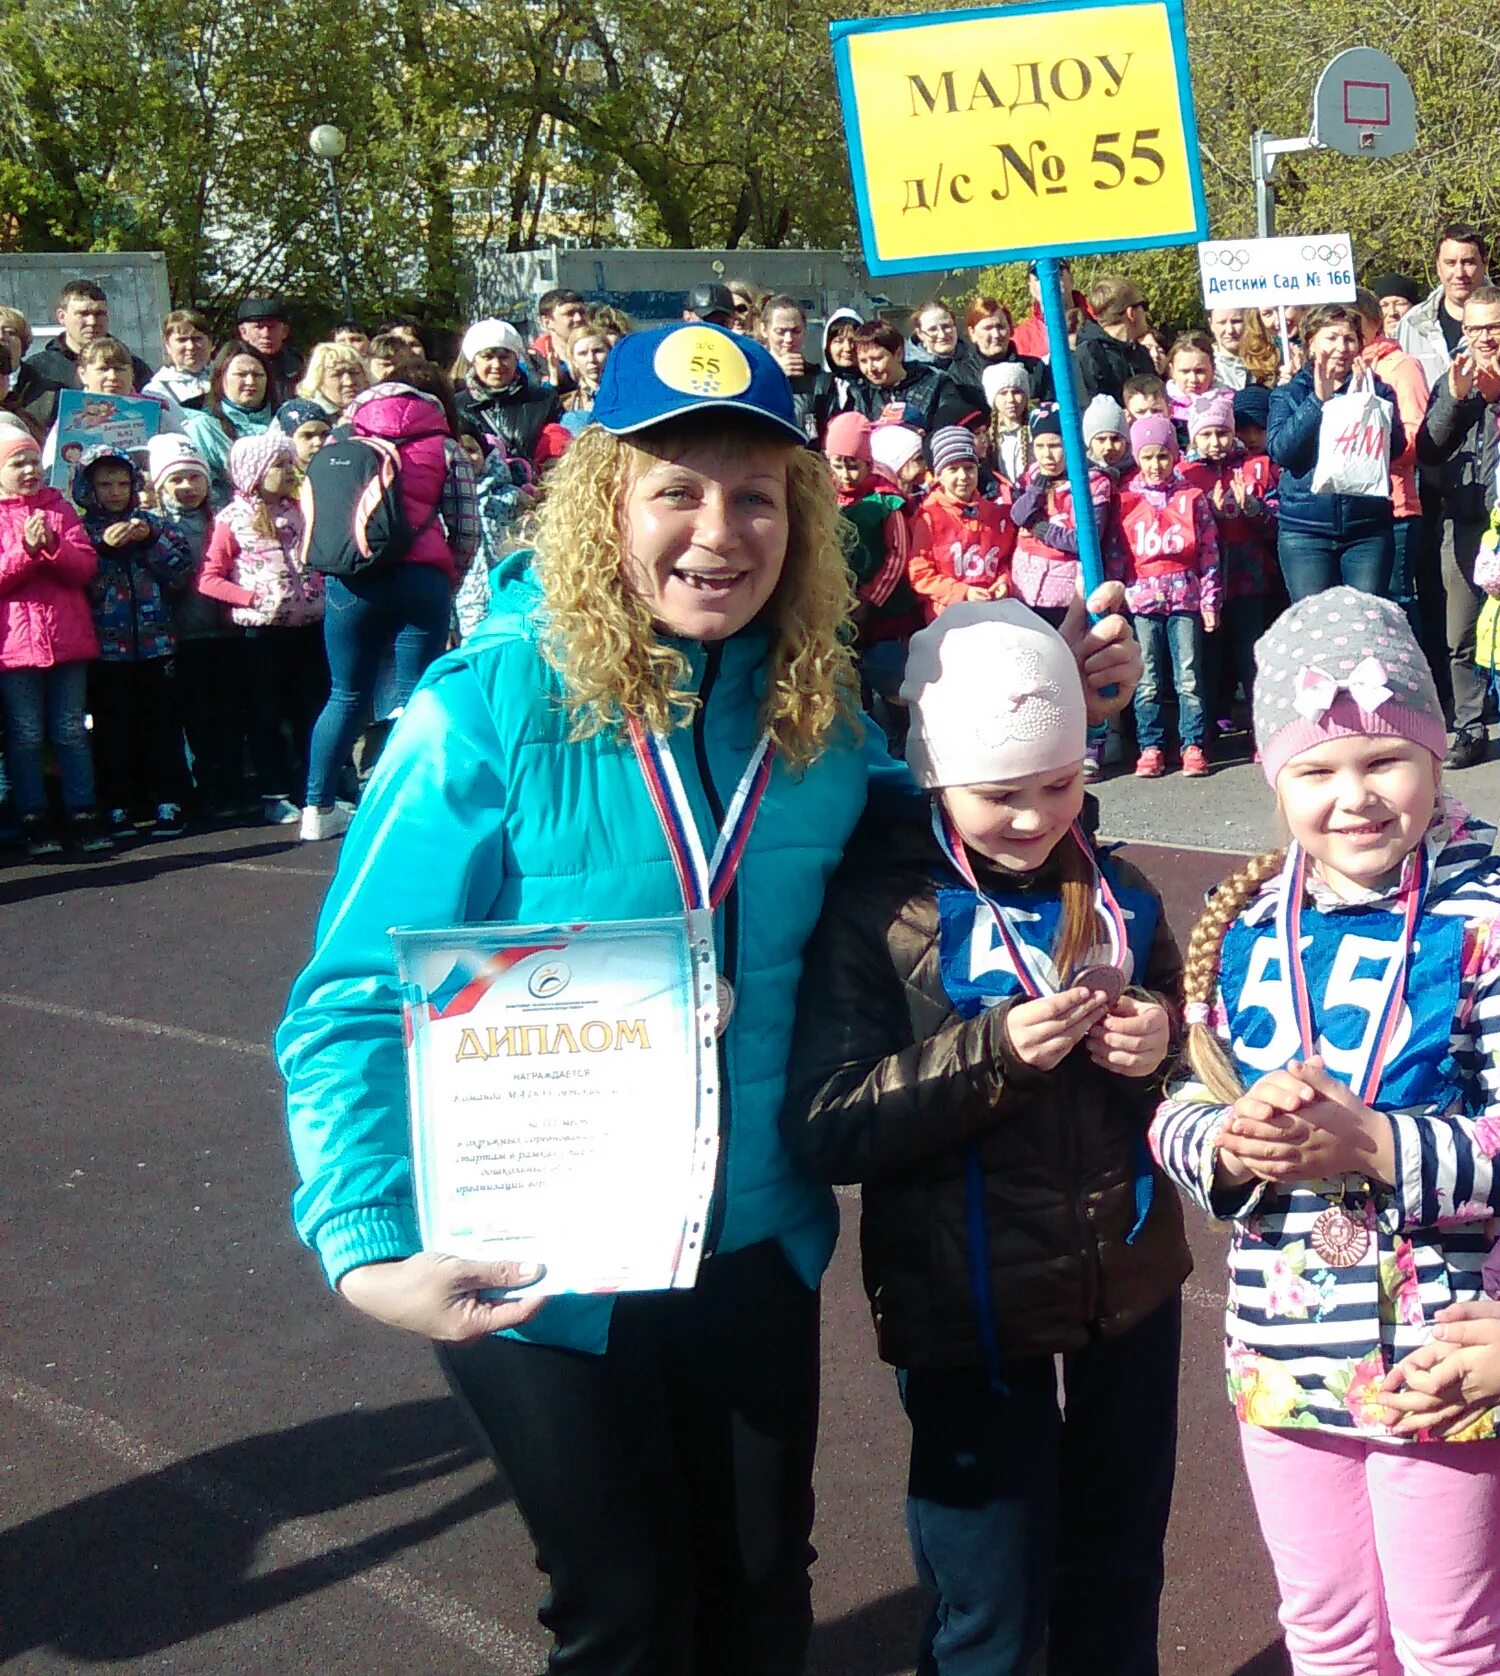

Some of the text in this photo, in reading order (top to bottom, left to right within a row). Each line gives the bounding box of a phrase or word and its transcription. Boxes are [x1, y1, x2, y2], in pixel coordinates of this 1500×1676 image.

[904, 52, 1134, 117] МАДОУ
[902, 128, 1166, 216] д/с № 55
[1209, 270, 1351, 294] Детский Сад № 166
[690, 356, 720, 374] 55
[1134, 520, 1184, 556] 166
[949, 541, 1000, 578] 166
[1232, 934, 1420, 1076] 55
[456, 1018, 652, 1062] ДИПЛОМ
[513, 1069, 590, 1081] НАГРАЖДАЕТСЯ
